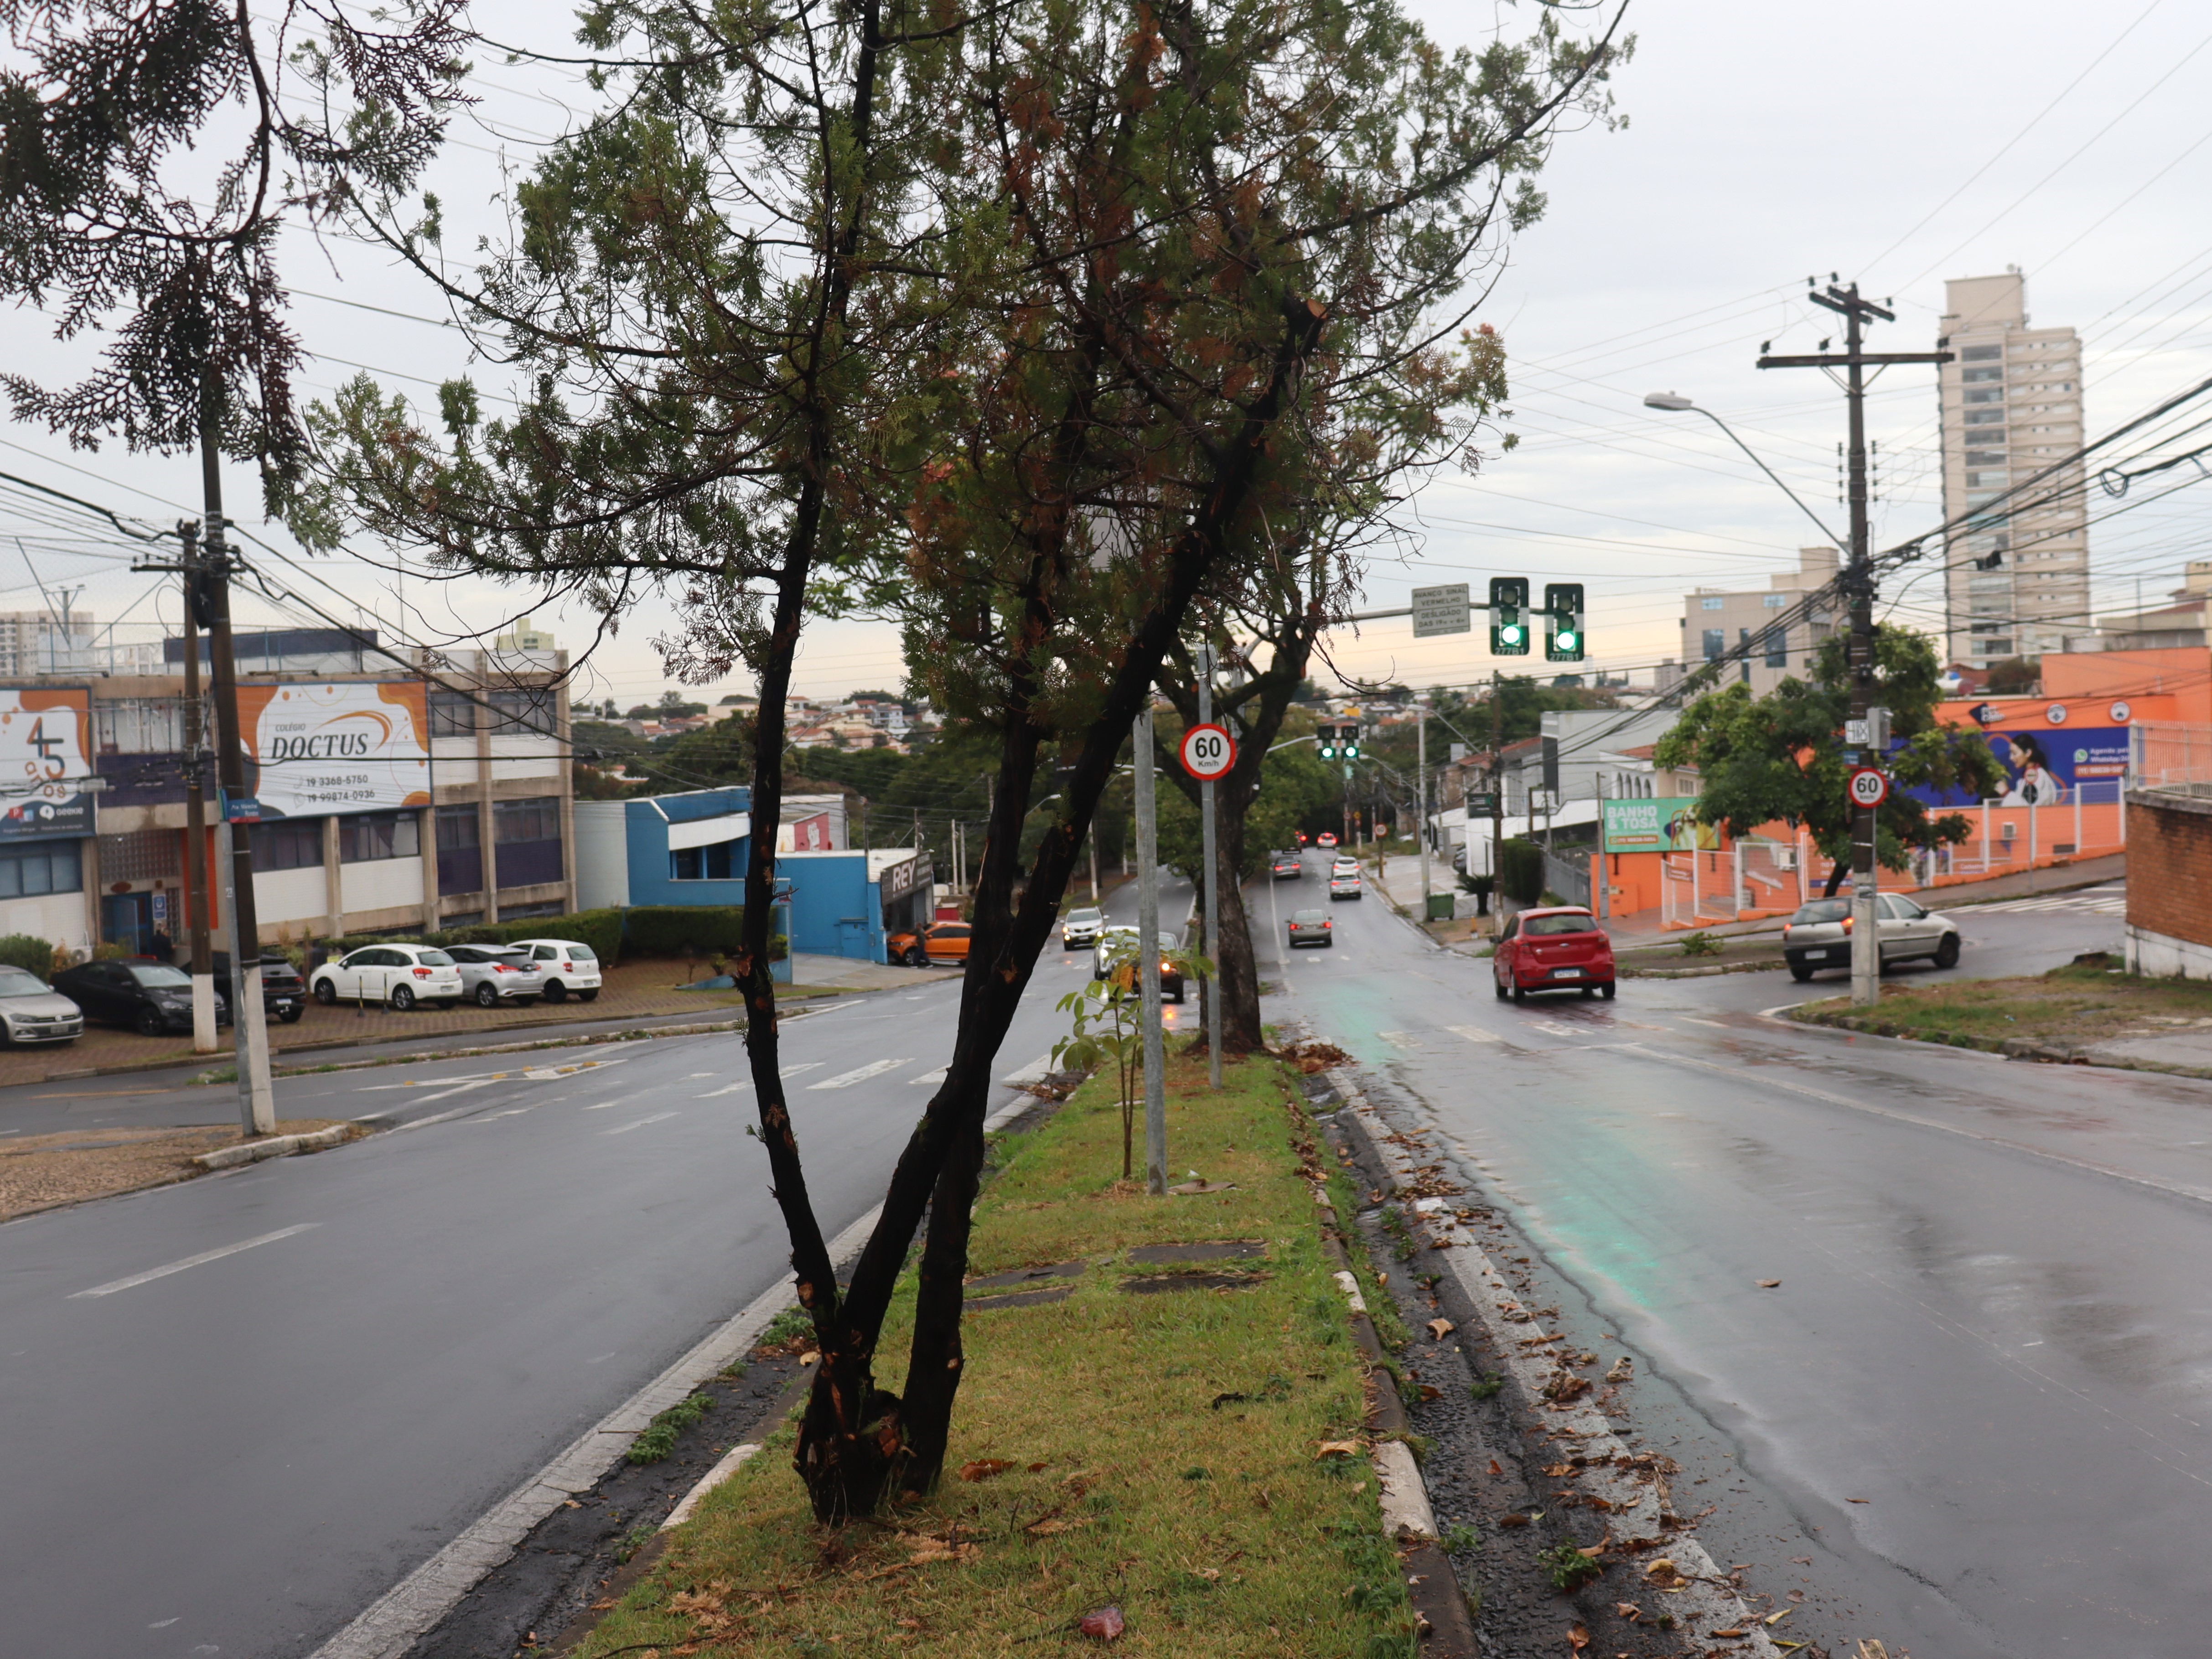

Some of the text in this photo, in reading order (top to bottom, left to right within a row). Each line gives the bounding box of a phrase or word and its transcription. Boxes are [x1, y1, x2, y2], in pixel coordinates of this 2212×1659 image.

[1421, 597, 1460, 606] VERMELHO
[1421, 609, 1461, 618] DESLIGADO
[275, 723, 306, 731] COLÉGIO
[271, 733, 368, 759] DOCTUS
[1195, 736, 1221, 758] 60
[306, 775, 368, 787] 19 3368-5750
[1857, 778, 1878, 793] 60
[307, 789, 375, 803] 19 99874-0936
[1607, 806, 1657, 818] BANHO
[1608, 817, 1658, 829] & TOSA
[893, 860, 916, 892] REY
